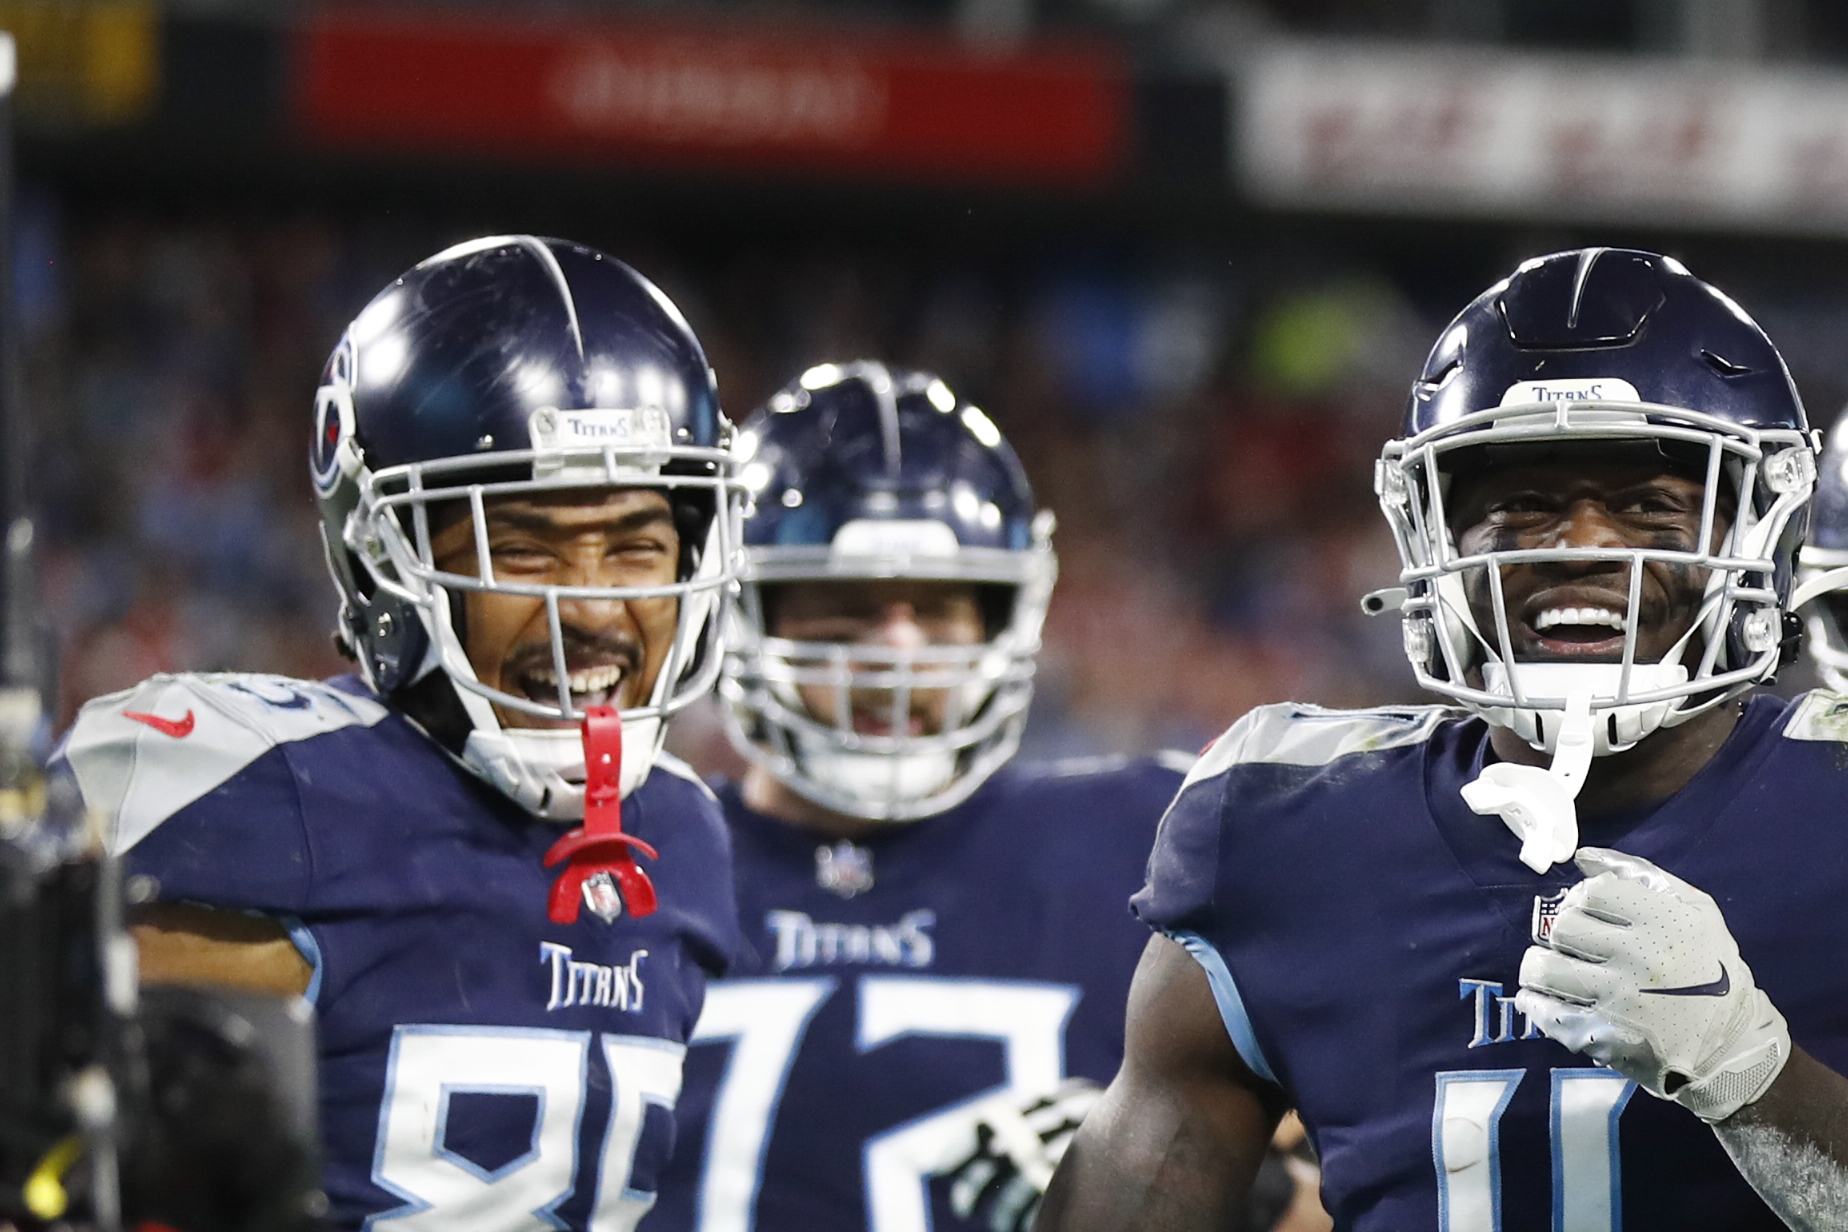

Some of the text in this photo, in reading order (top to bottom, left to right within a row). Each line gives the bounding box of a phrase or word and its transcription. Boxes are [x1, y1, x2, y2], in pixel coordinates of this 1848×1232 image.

[567, 418, 628, 437] TITANS
[763, 908, 937, 976] TITANS
[540, 940, 648, 1014] TITANS
